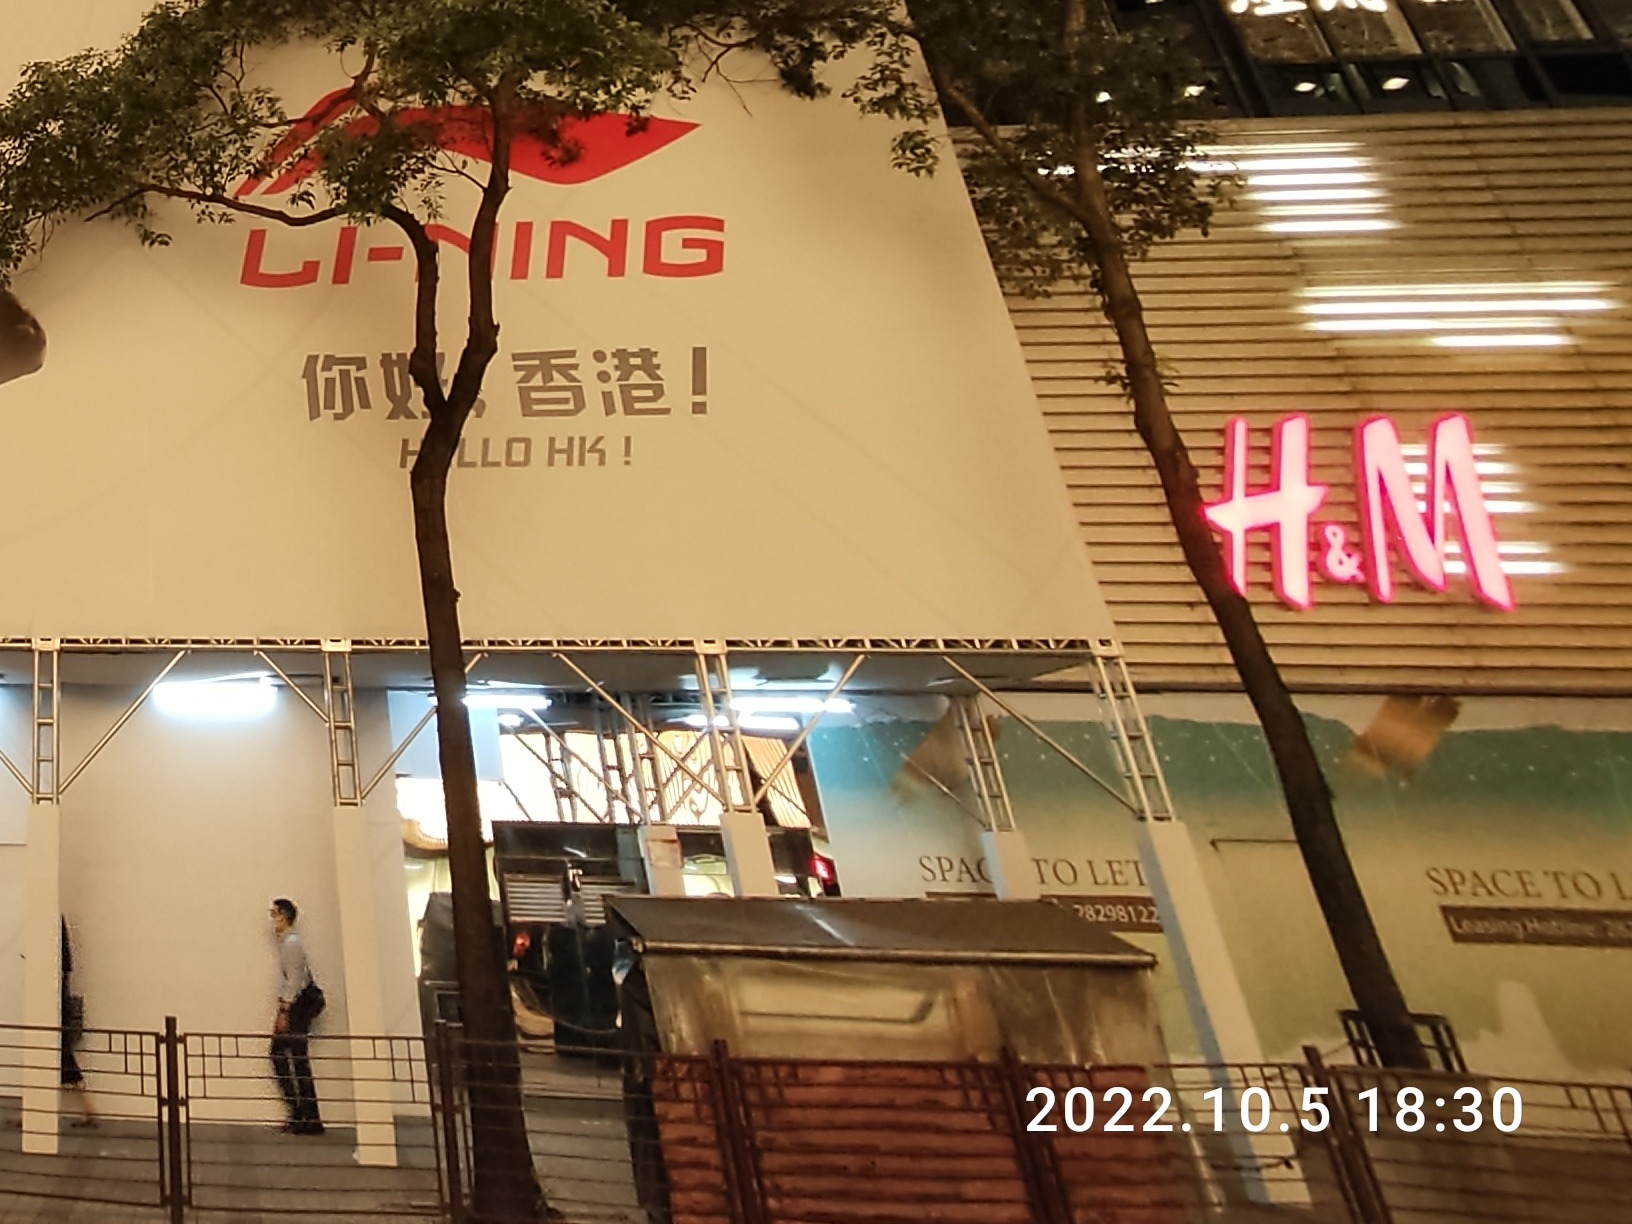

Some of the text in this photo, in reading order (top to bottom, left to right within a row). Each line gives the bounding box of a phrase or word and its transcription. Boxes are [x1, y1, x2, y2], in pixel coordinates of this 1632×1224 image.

[400, 436, 532, 469] HLLO
[1202, 412, 1516, 613] H&M
[919, 855, 1148, 887] SPAC TO LET
[1425, 867, 1542, 898] SPACE
[1542, 870, 1602, 901] TO
